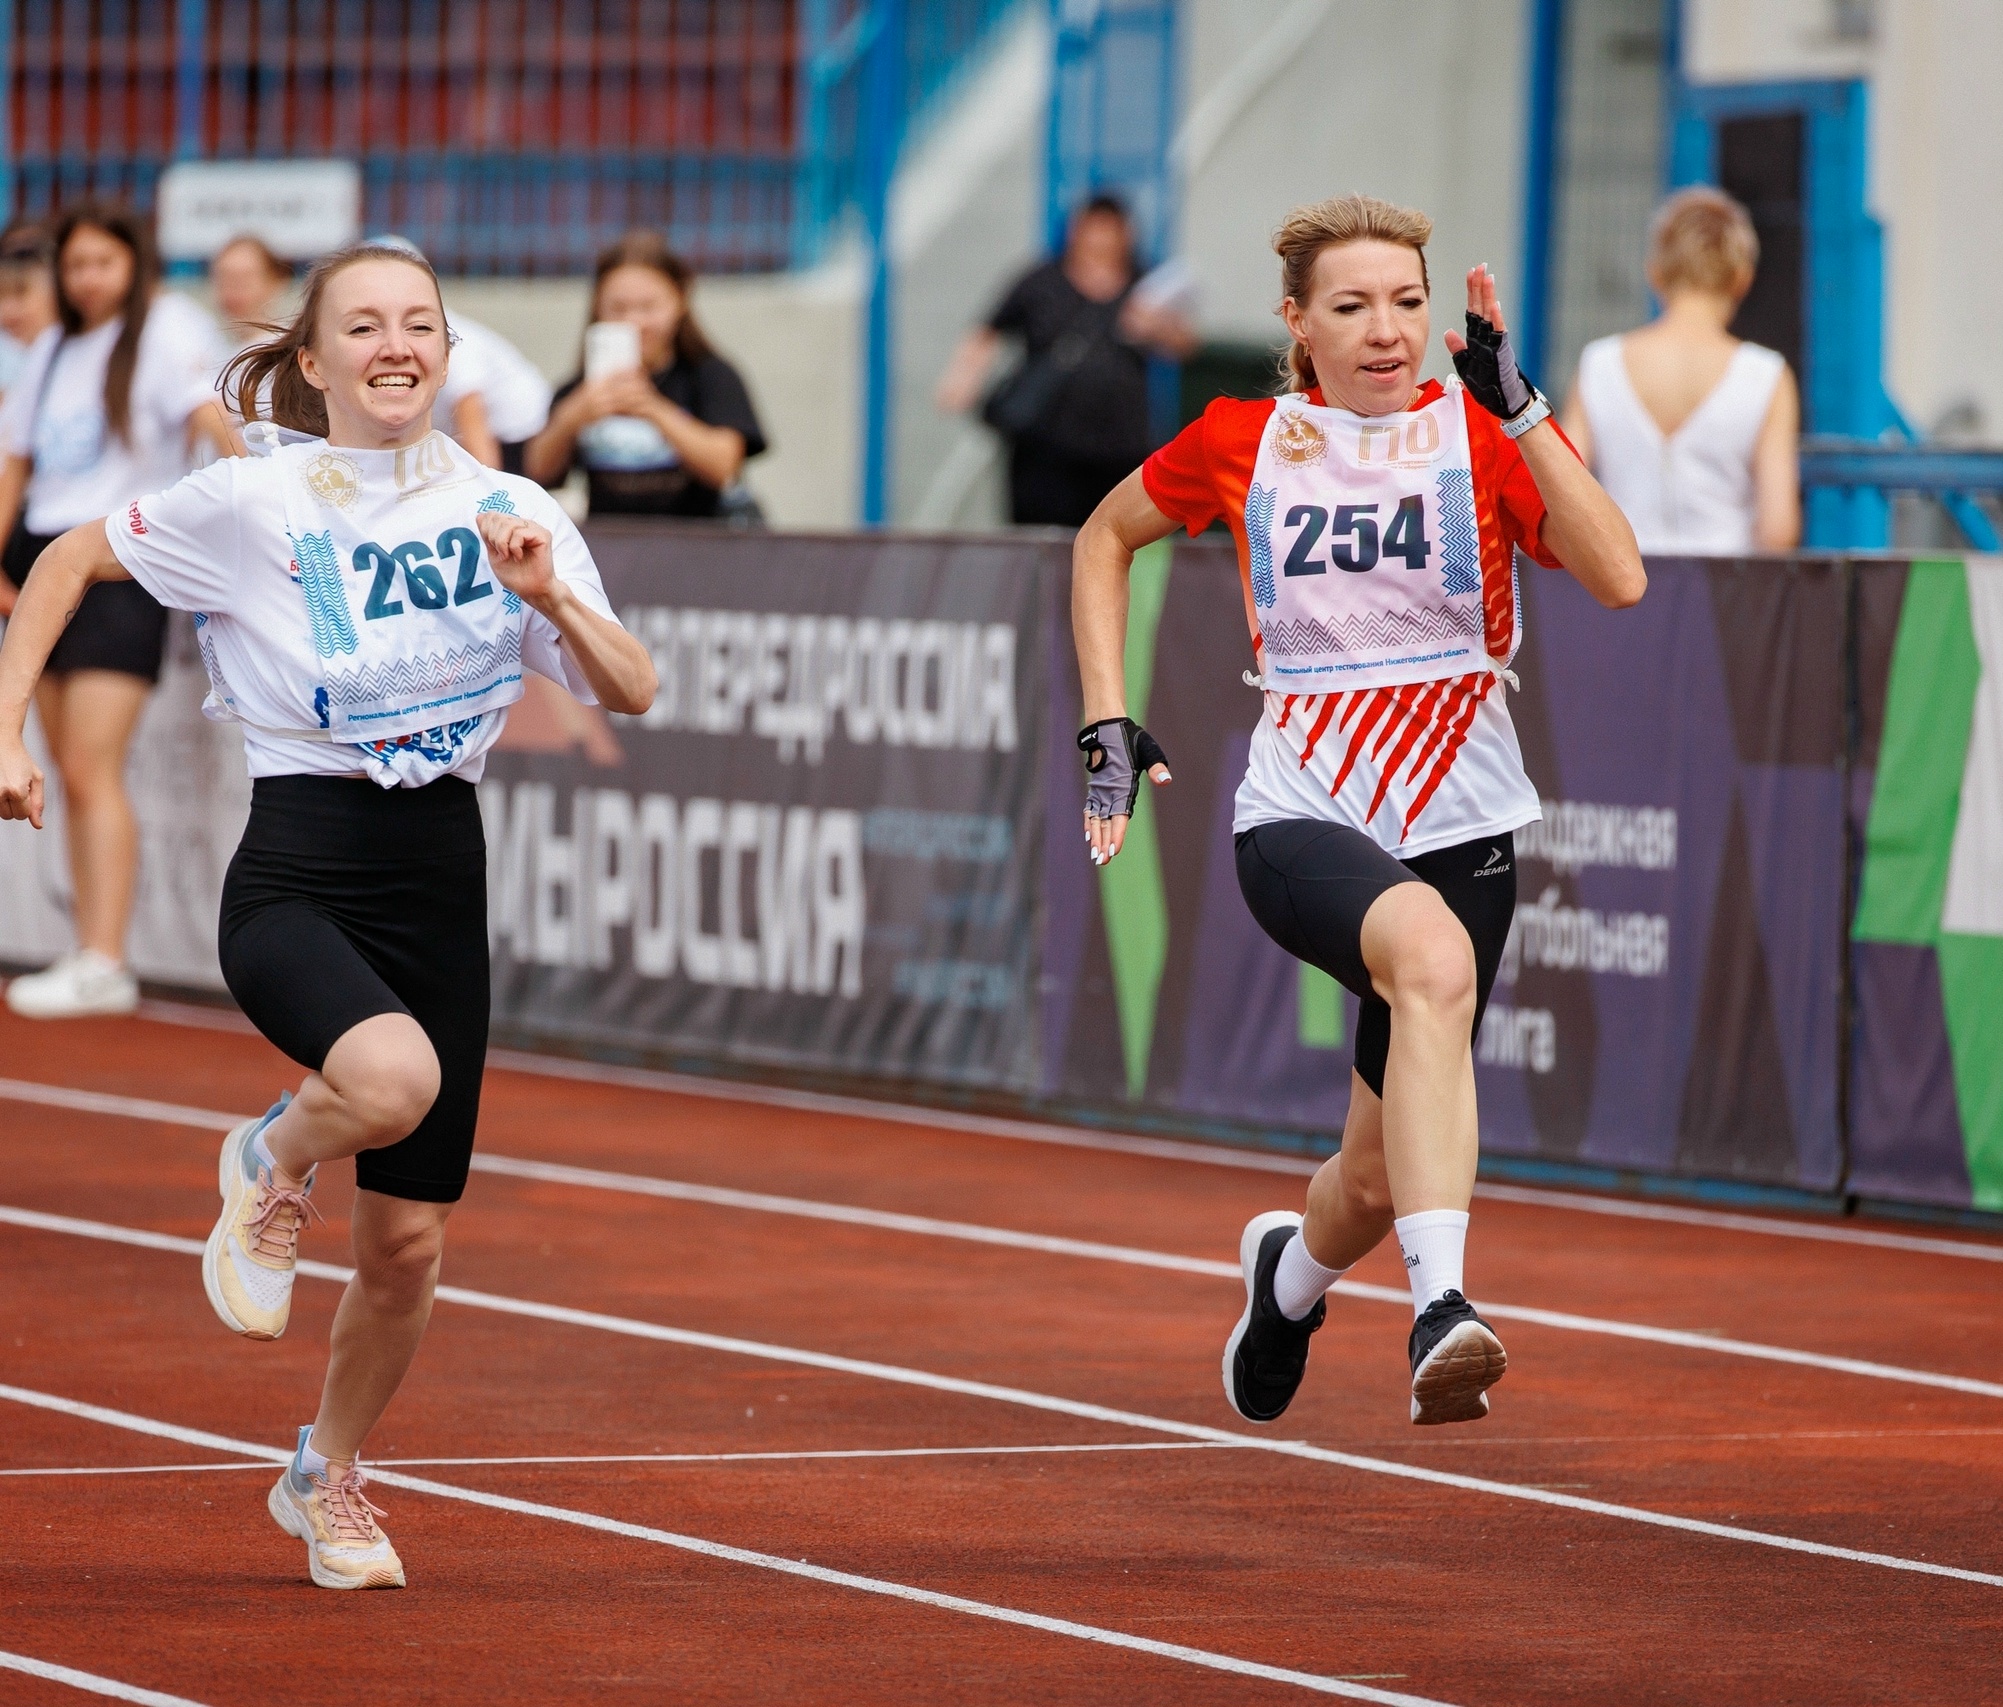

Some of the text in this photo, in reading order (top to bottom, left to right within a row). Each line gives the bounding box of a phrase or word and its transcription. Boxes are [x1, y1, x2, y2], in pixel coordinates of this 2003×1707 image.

[1283, 493, 1431, 577] 254
[352, 527, 494, 621] 262
[610, 606, 1018, 767] ВПЕРЕДРОССИЯ
[1313, 665, 1334, 673] центр
[1335, 660, 1384, 672] тестирования
[1385, 651, 1442, 666] Нижегородской
[1443, 648, 1470, 658] области
[348, 708, 402, 722] Региональный
[402, 704, 420, 715] центр
[421, 694, 462, 710] тестирования
[504, 673, 522, 683] обла
[1473, 862, 1511, 877] DEMIX
